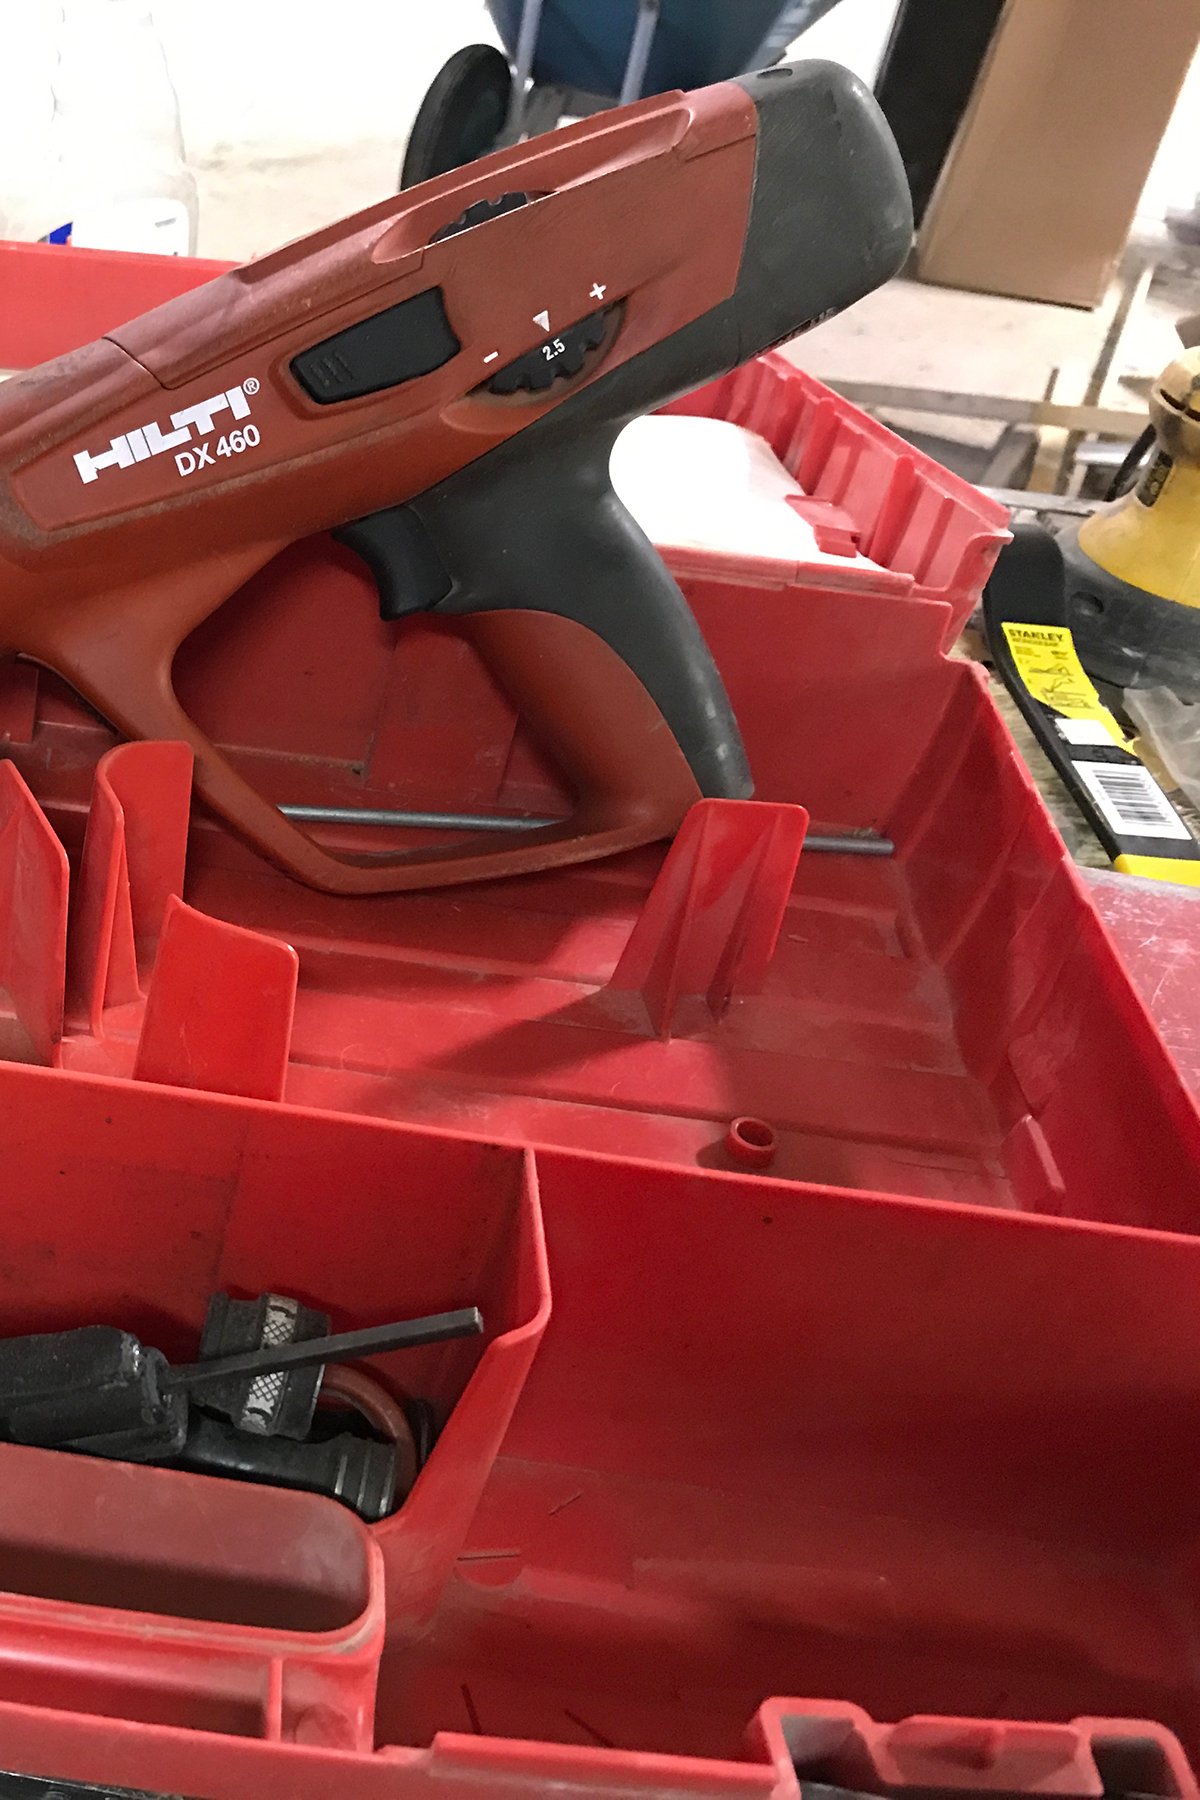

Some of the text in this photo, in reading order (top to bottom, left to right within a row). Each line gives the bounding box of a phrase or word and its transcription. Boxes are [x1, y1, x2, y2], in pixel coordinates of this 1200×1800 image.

[542, 338, 566, 361] 2.5
[174, 424, 261, 477] DX 460
[1008, 629, 1063, 641] STANLEY
